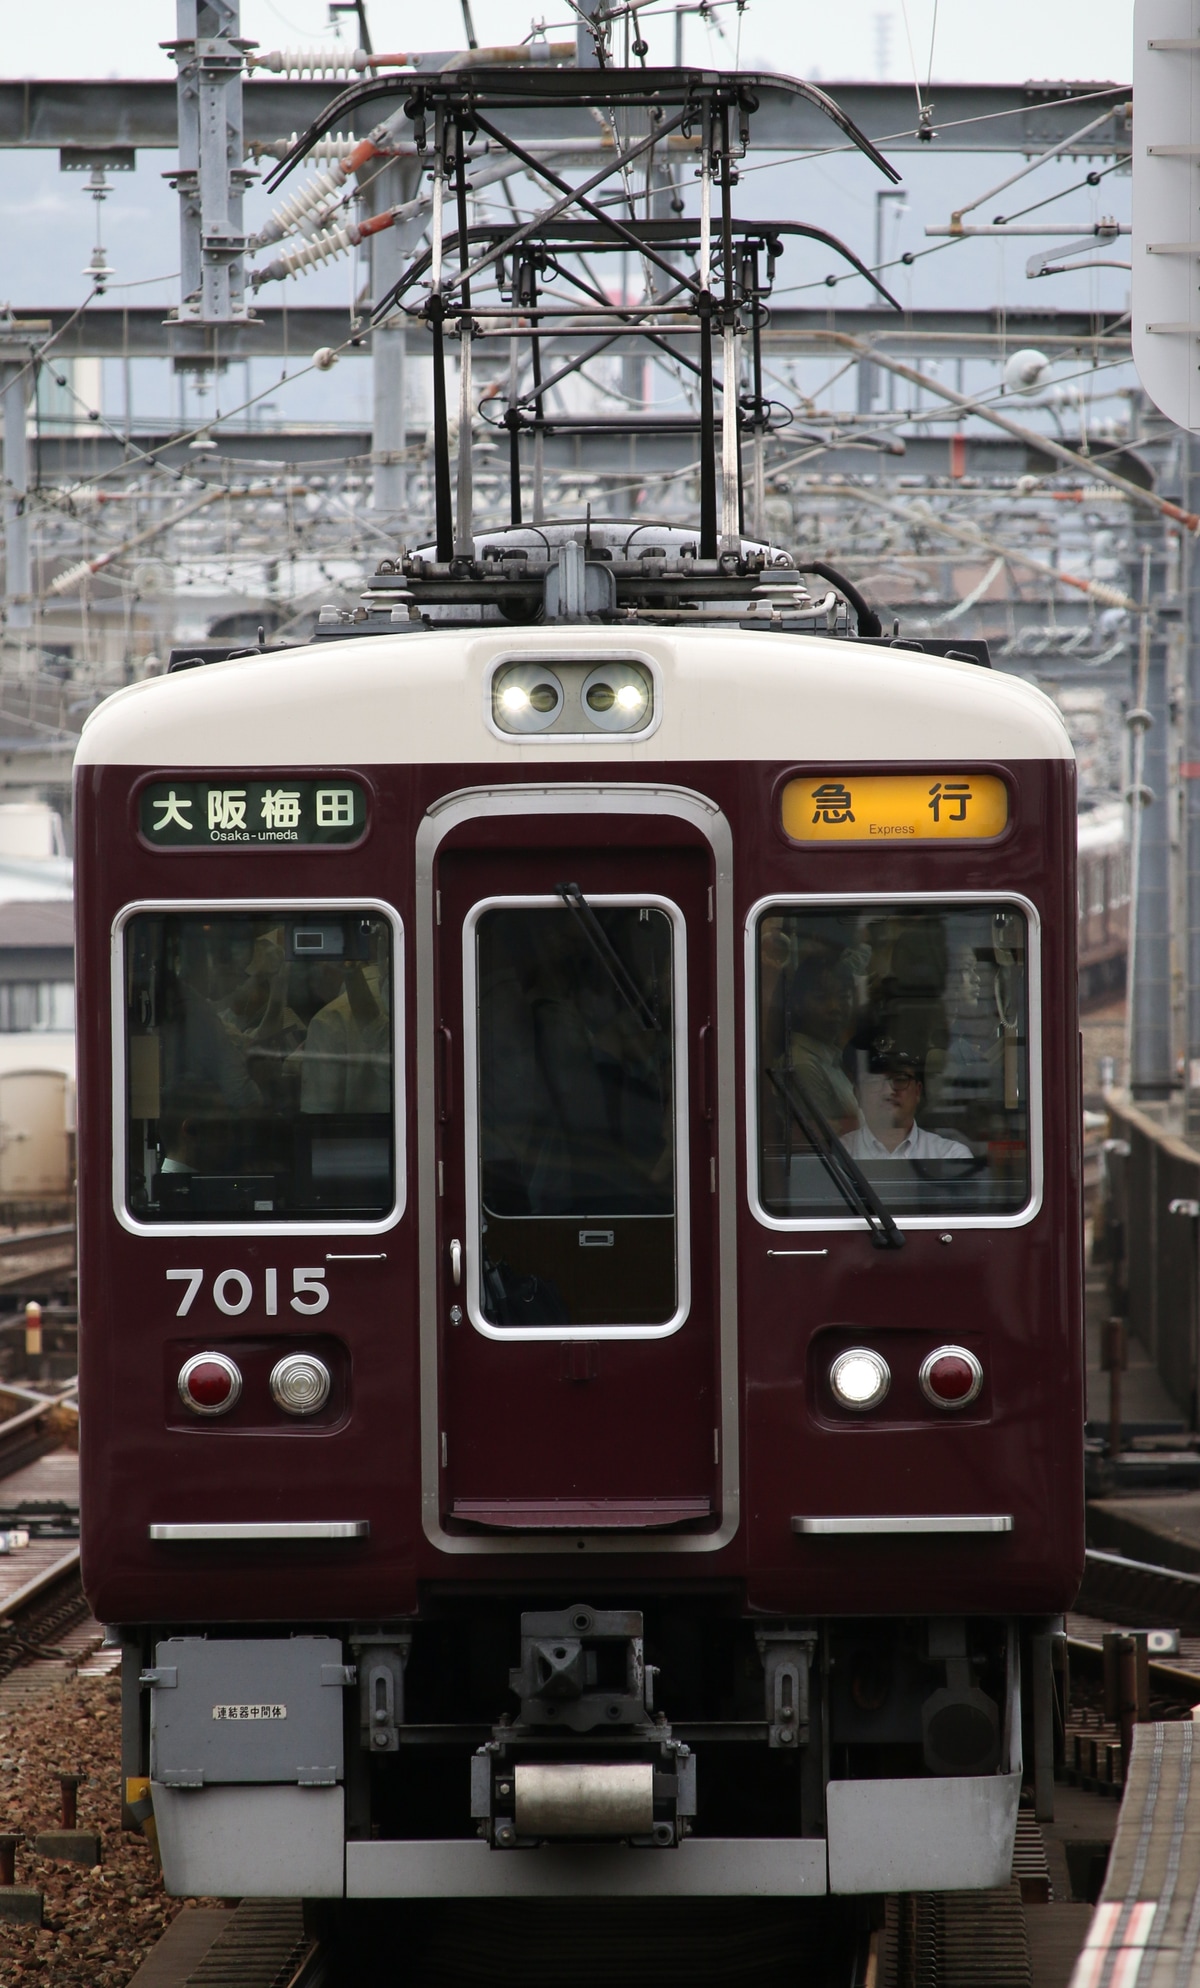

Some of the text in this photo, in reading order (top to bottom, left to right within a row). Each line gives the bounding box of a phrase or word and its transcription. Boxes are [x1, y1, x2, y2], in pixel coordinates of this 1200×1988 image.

[153, 789, 354, 831] 大阪梅田
[811, 783, 972, 824] 急行
[210, 830, 298, 841] Osaka-umeda
[869, 824, 915, 836] Express
[166, 1268, 330, 1317] 7015
[217, 1705, 282, 1719] 連結器中間体
